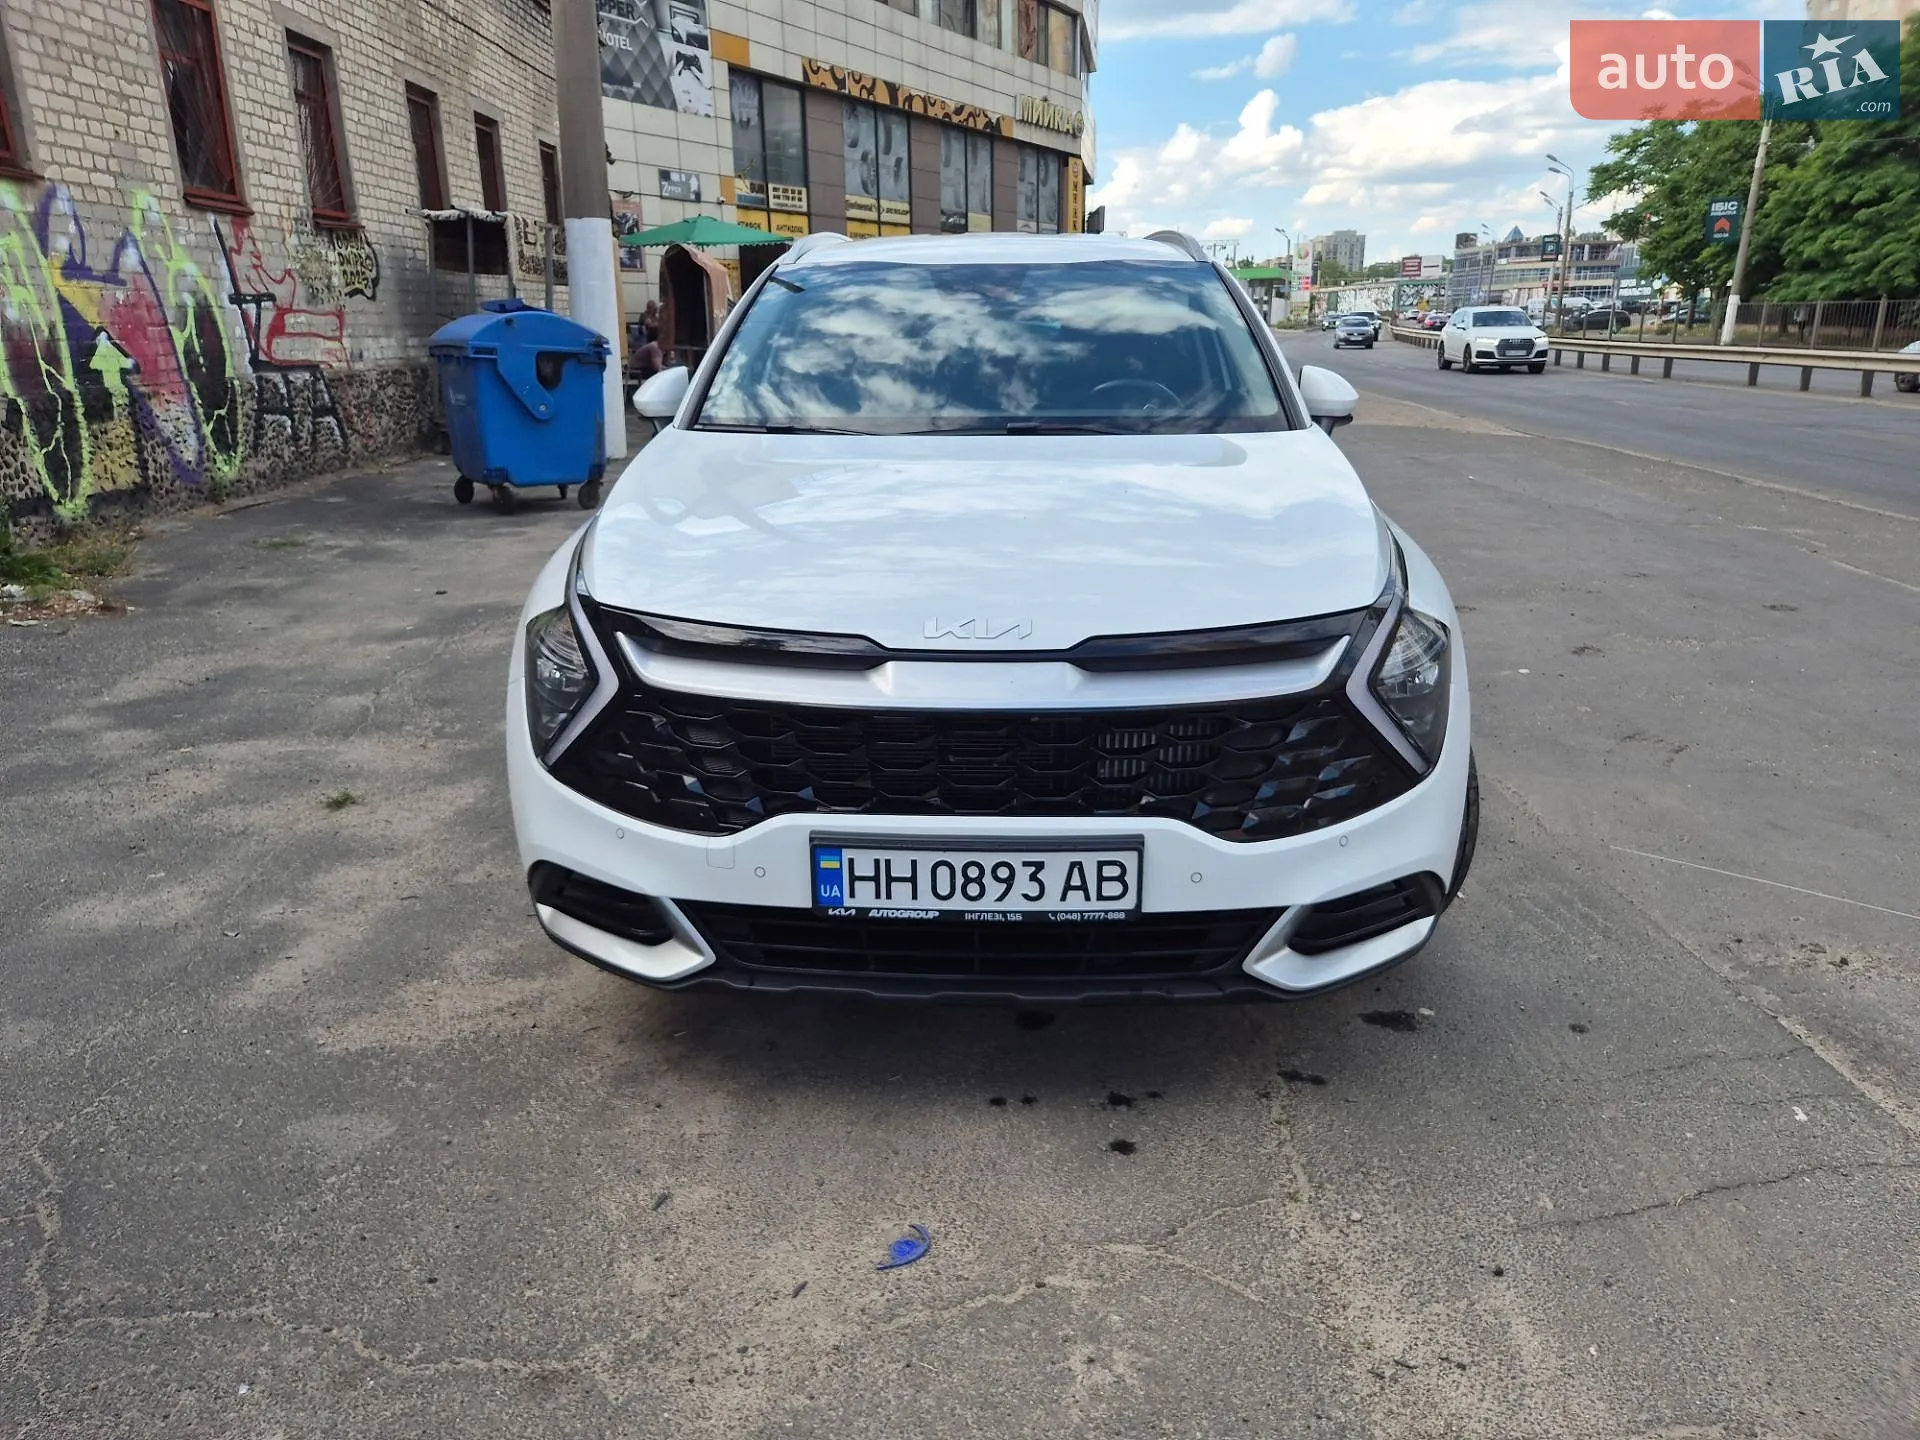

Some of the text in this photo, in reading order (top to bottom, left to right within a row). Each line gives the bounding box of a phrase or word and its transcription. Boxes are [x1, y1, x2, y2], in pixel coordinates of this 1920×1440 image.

[821, 884, 841, 898] UA
[848, 857, 1129, 902] HH 0893 AB
